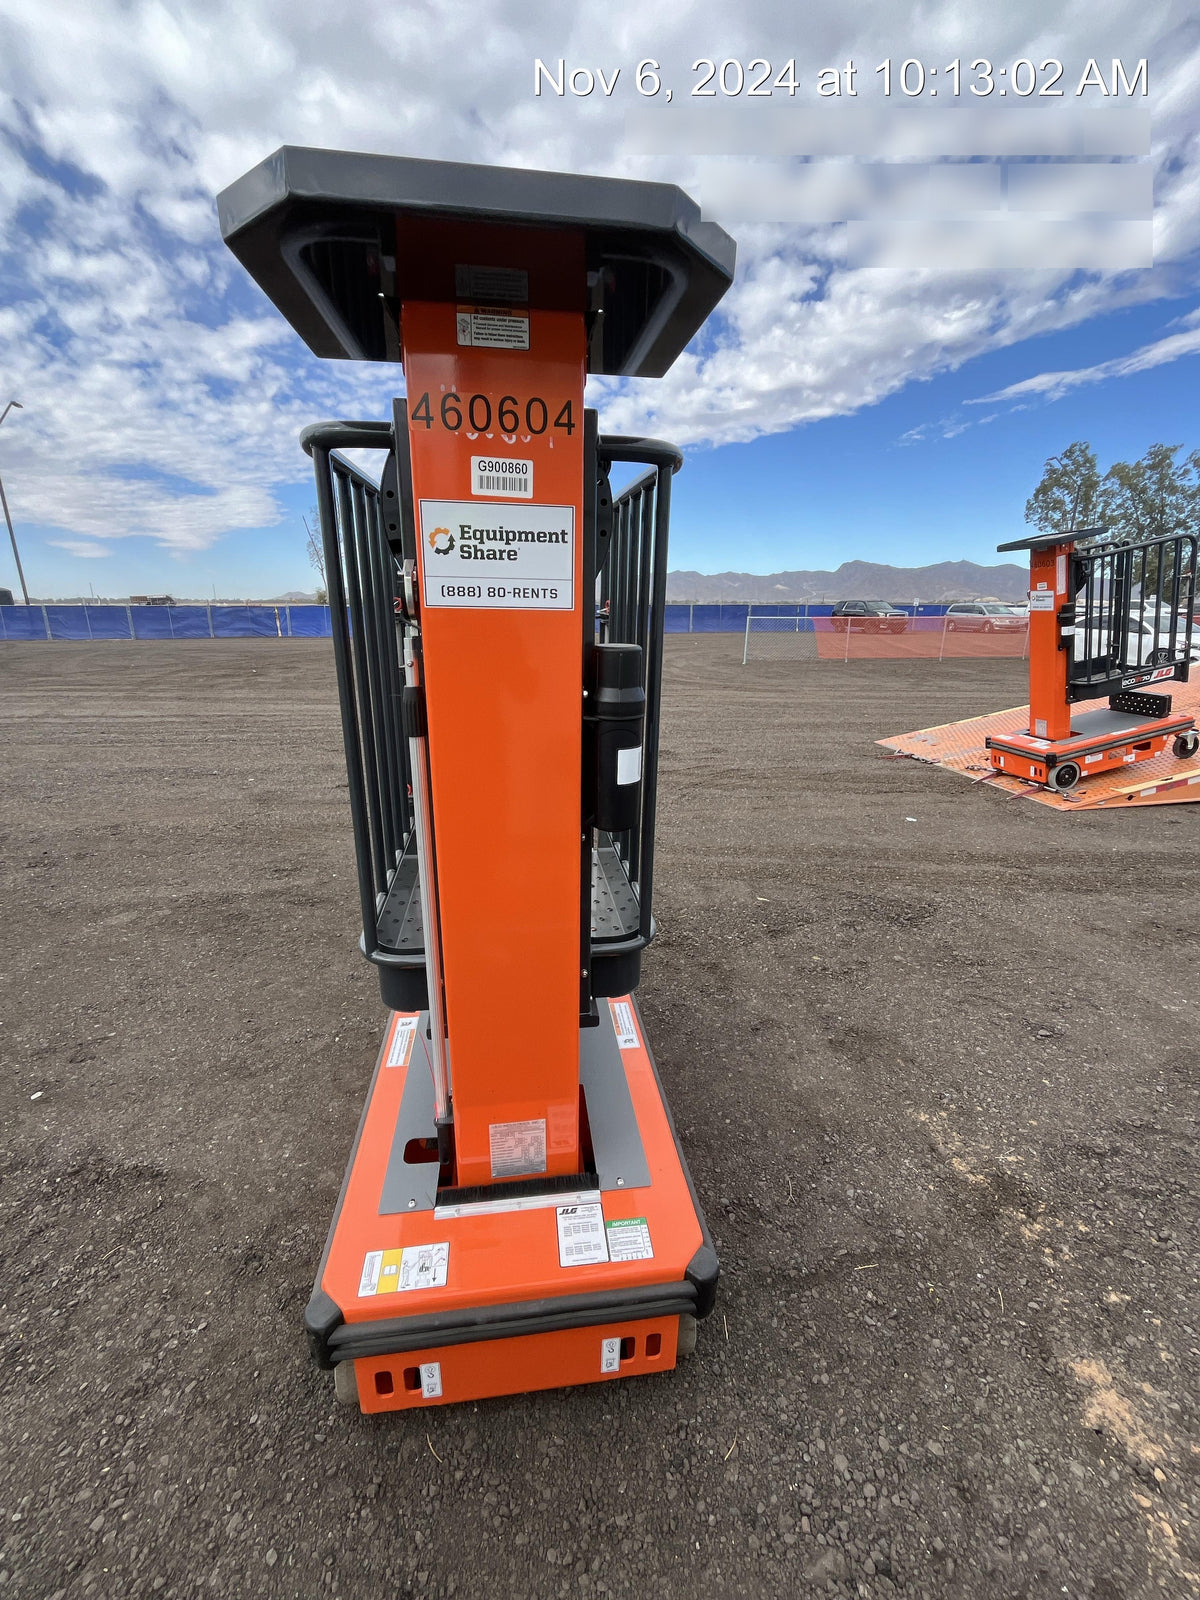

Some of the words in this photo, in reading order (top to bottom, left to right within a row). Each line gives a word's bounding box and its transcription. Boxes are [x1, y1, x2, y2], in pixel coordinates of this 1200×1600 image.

[411, 391, 576, 436] 460604
[478, 460, 528, 475] G900860
[459, 524, 568, 546] Equipment
[459, 543, 518, 561] Share
[441, 584, 482, 598] (888)
[487, 586, 558, 599] 80-RENTS
[1154, 668, 1173, 679] JLG
